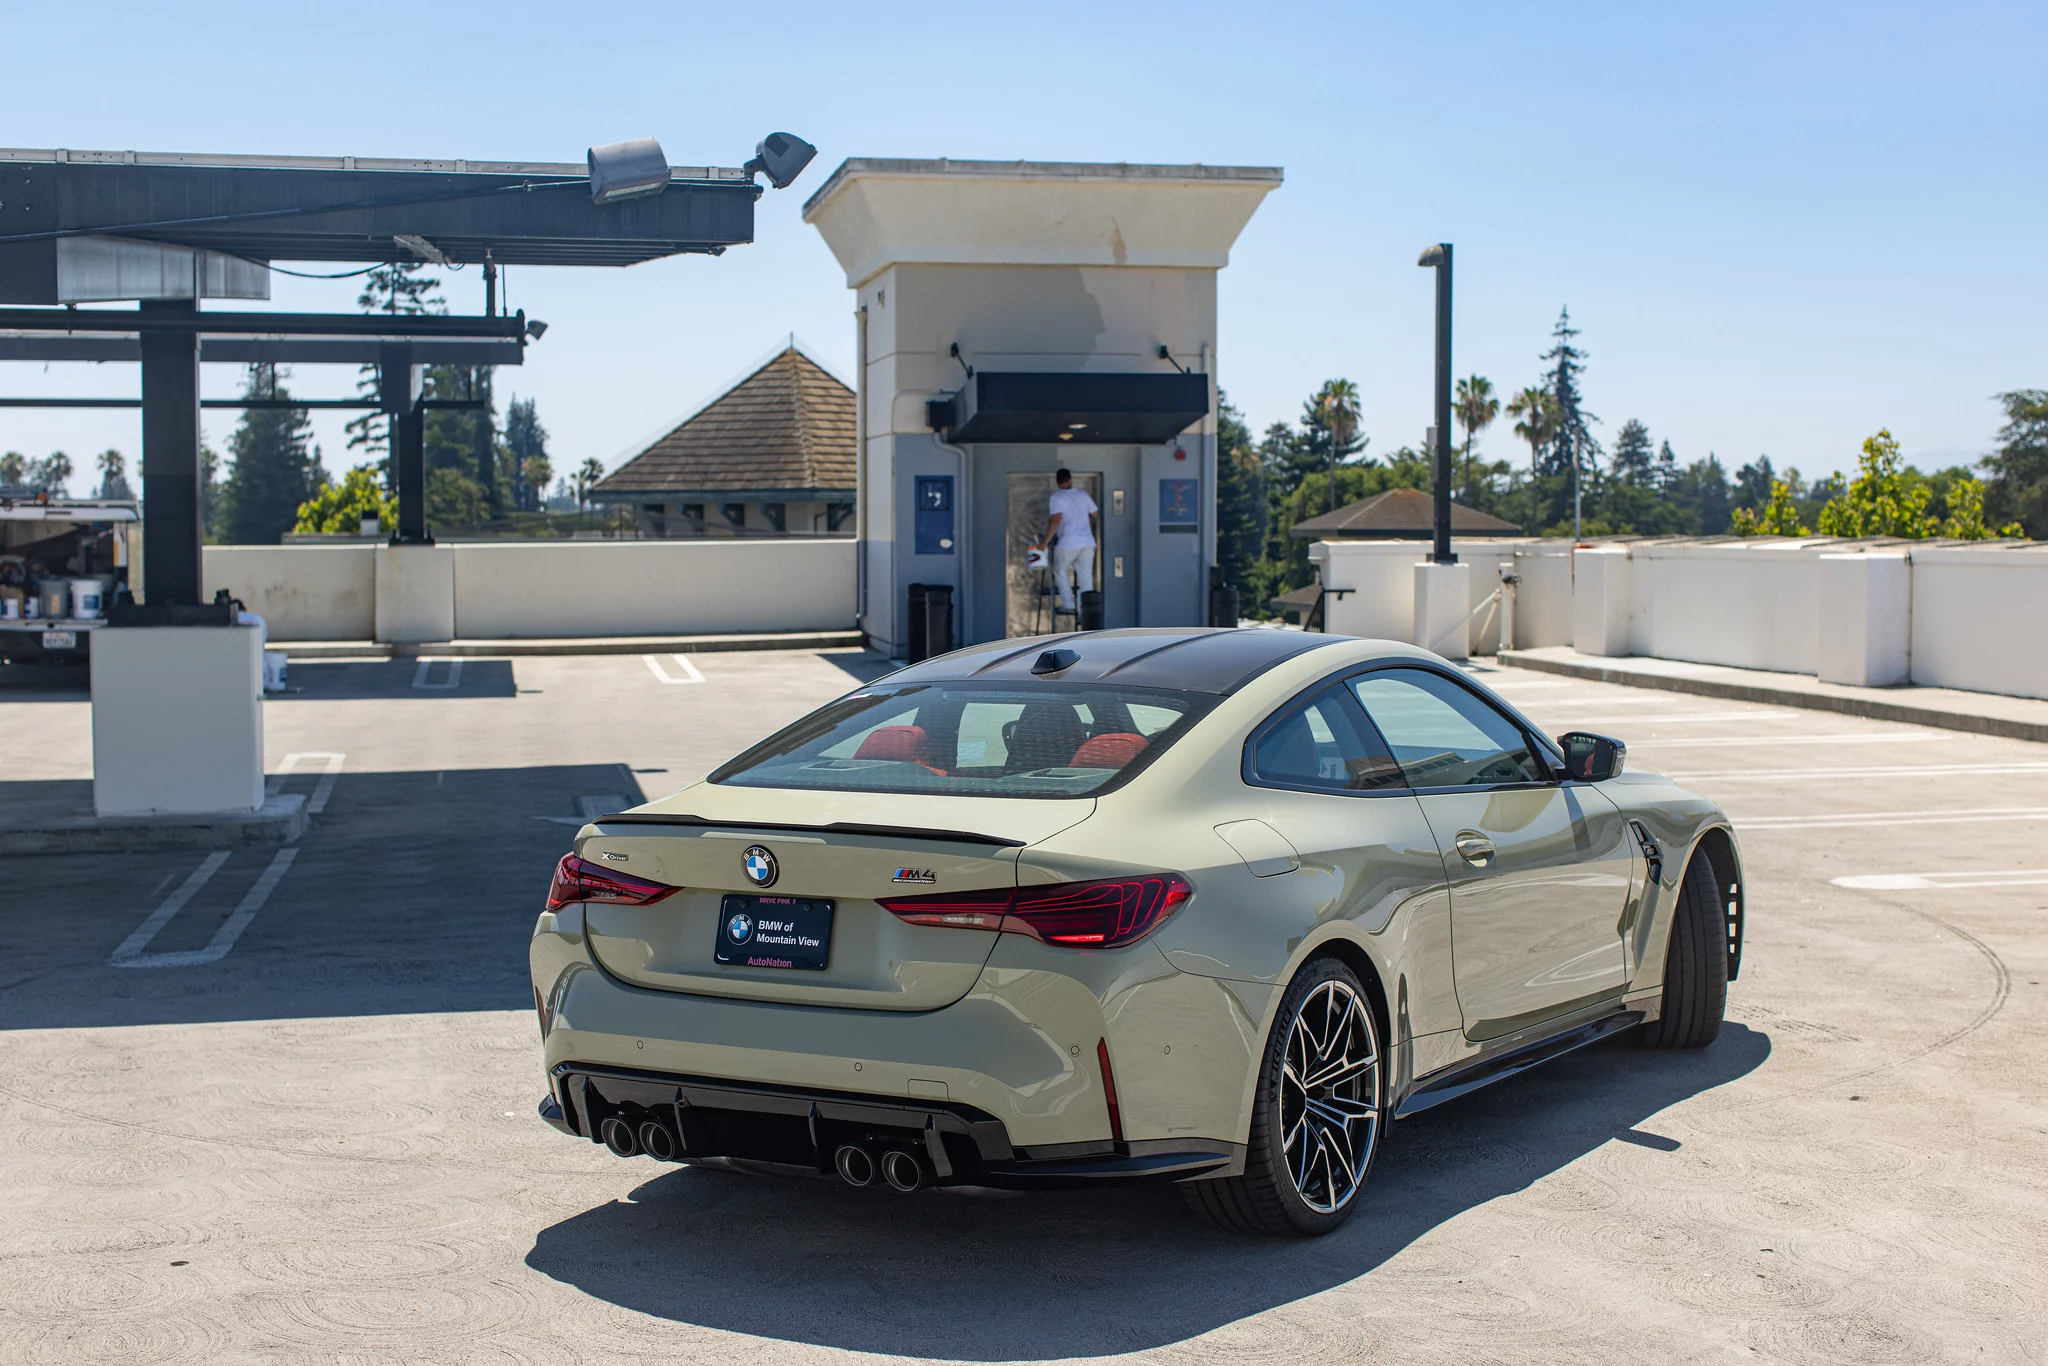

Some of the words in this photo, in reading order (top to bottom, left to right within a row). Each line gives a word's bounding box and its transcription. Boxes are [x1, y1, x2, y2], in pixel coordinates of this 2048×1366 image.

[907, 869, 936, 879] M4
[759, 920, 783, 931] BMW
[784, 922, 794, 931] of
[757, 933, 796, 945] Mountain
[798, 936, 819, 947] View
[747, 956, 792, 968] AutoNation
[1272, 1010, 1291, 1082] MICHELIN
